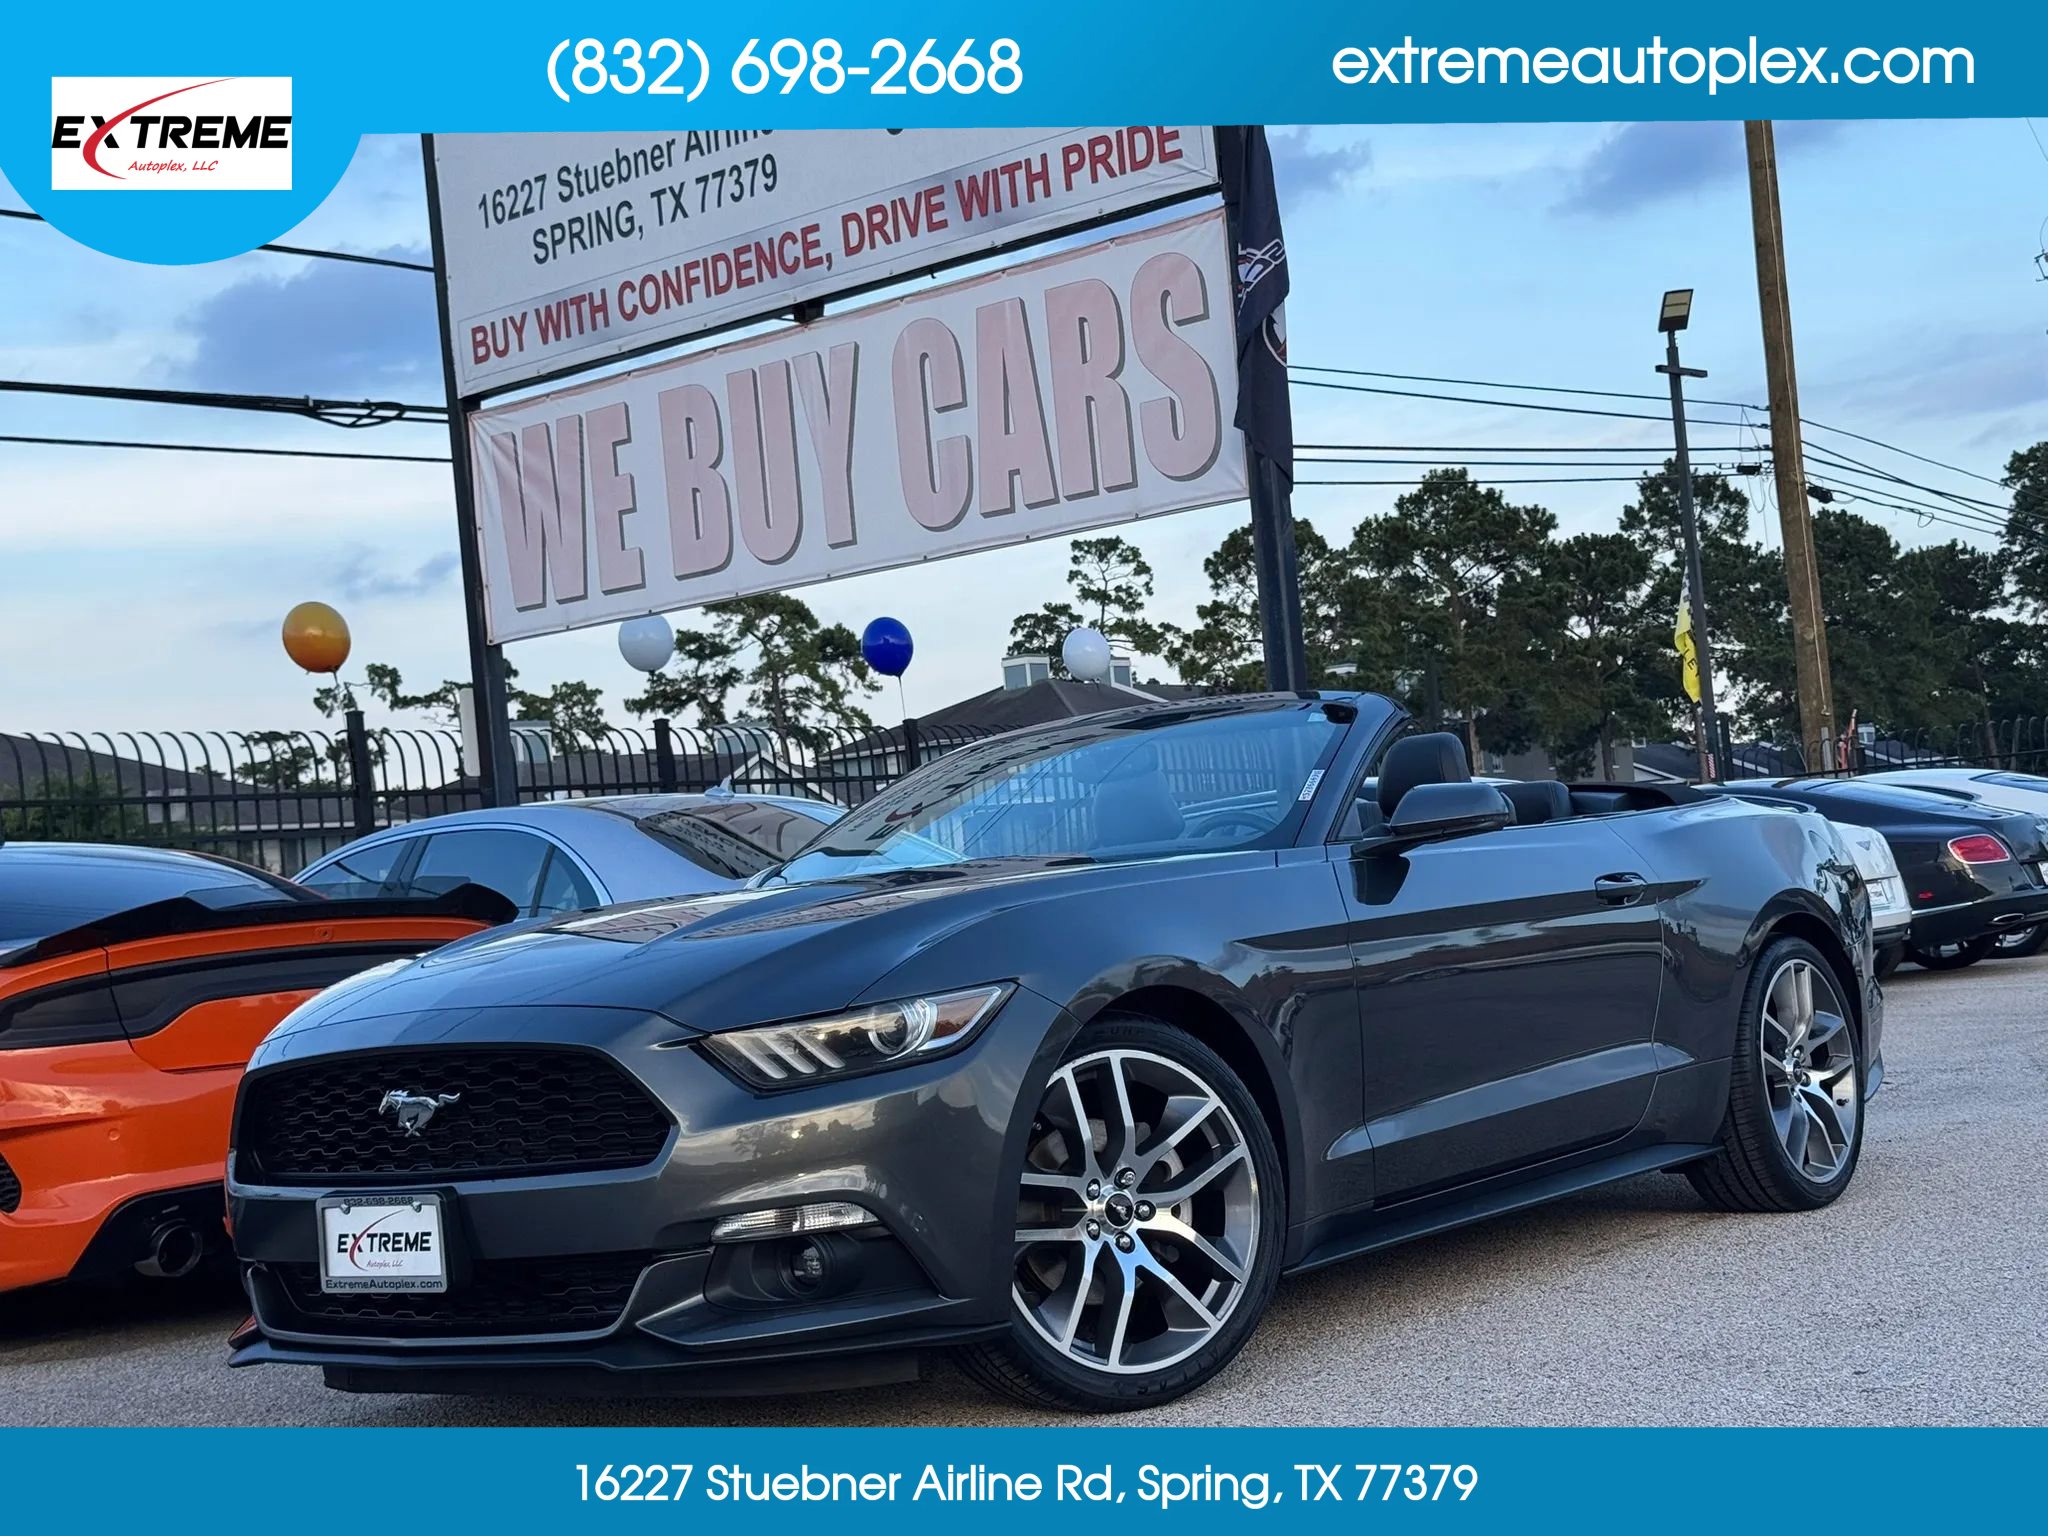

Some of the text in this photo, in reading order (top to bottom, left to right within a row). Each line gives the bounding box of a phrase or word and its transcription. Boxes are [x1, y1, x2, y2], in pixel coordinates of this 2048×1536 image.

[478, 174, 548, 229] 16227
[557, 138, 676, 203] Stuebner
[533, 153, 779, 265] SPRING, TX 77379
[471, 126, 1184, 365] BUY WITH CONFIDENCE, DRIVE WITH PRIDE
[490, 252, 1224, 613] WE BUY CARS
[325, 1279, 443, 1290] ExtremeAutoplex.com
[337, 1231, 432, 1254] EXTREME
